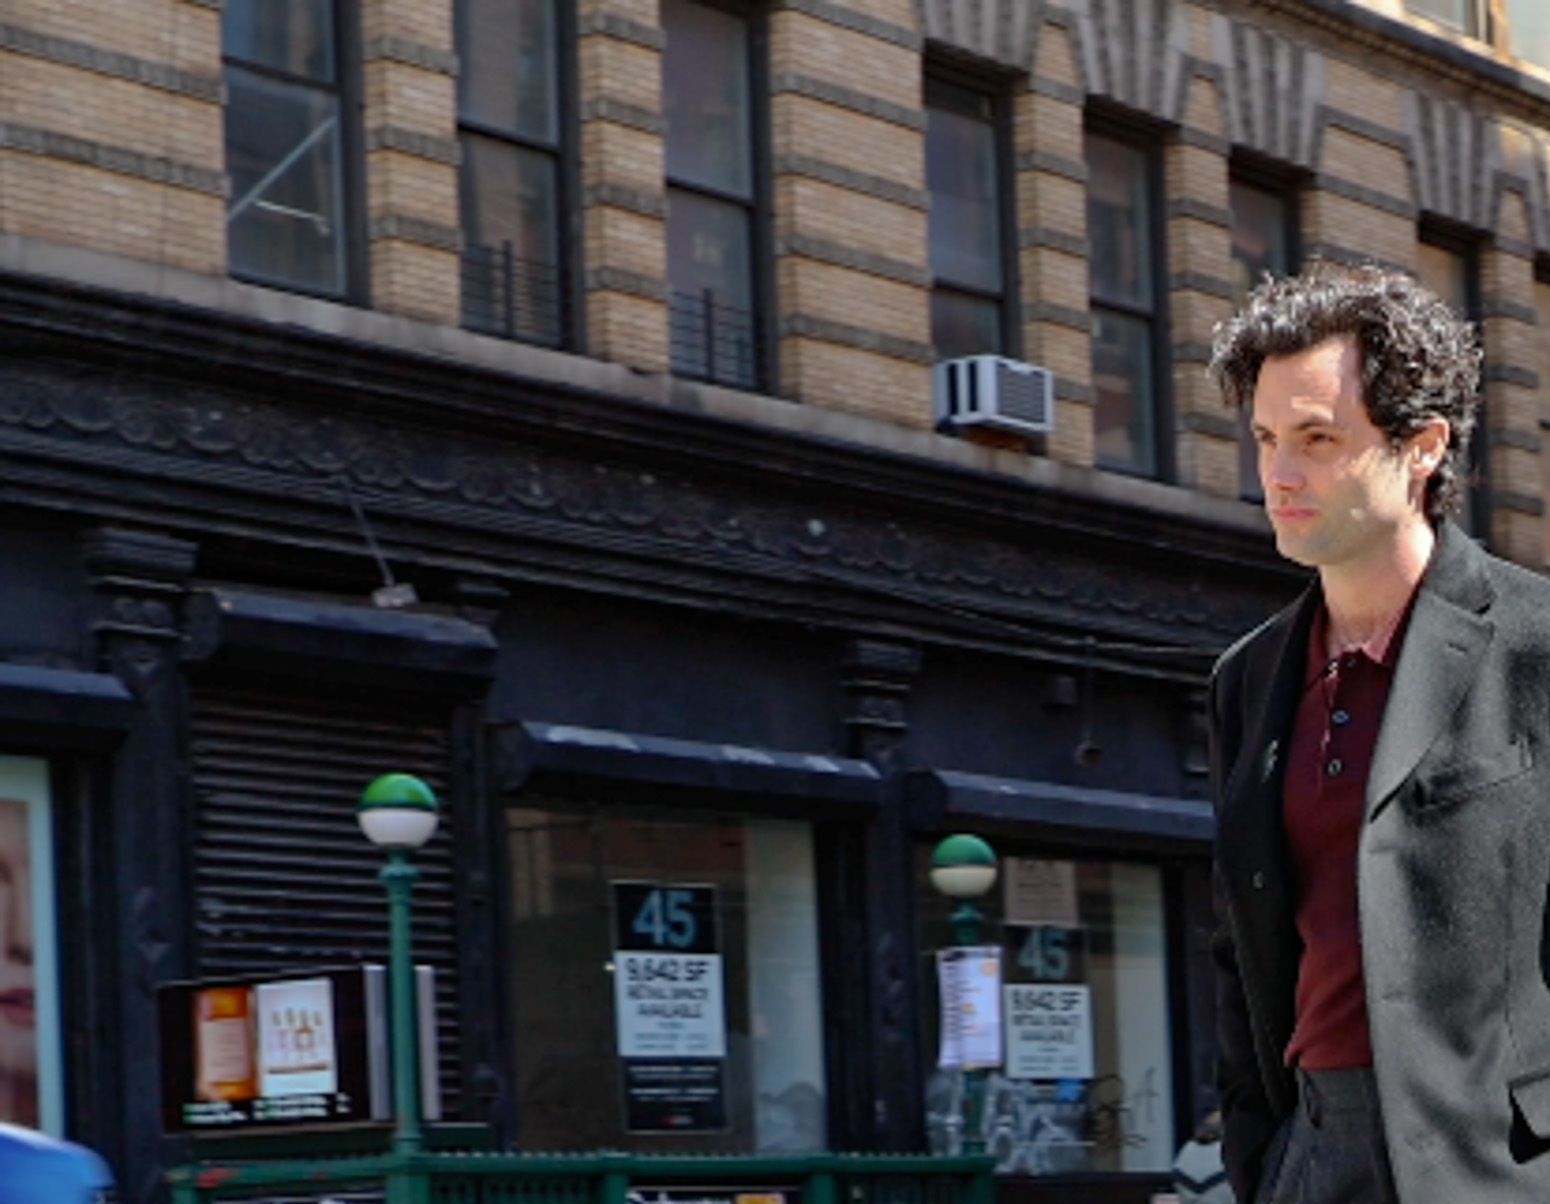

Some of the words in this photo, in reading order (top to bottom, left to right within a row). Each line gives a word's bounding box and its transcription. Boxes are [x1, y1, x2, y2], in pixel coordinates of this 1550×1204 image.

[632, 889, 697, 947] 45
[684, 961, 710, 982] SF
[1018, 928, 1069, 980] 45
